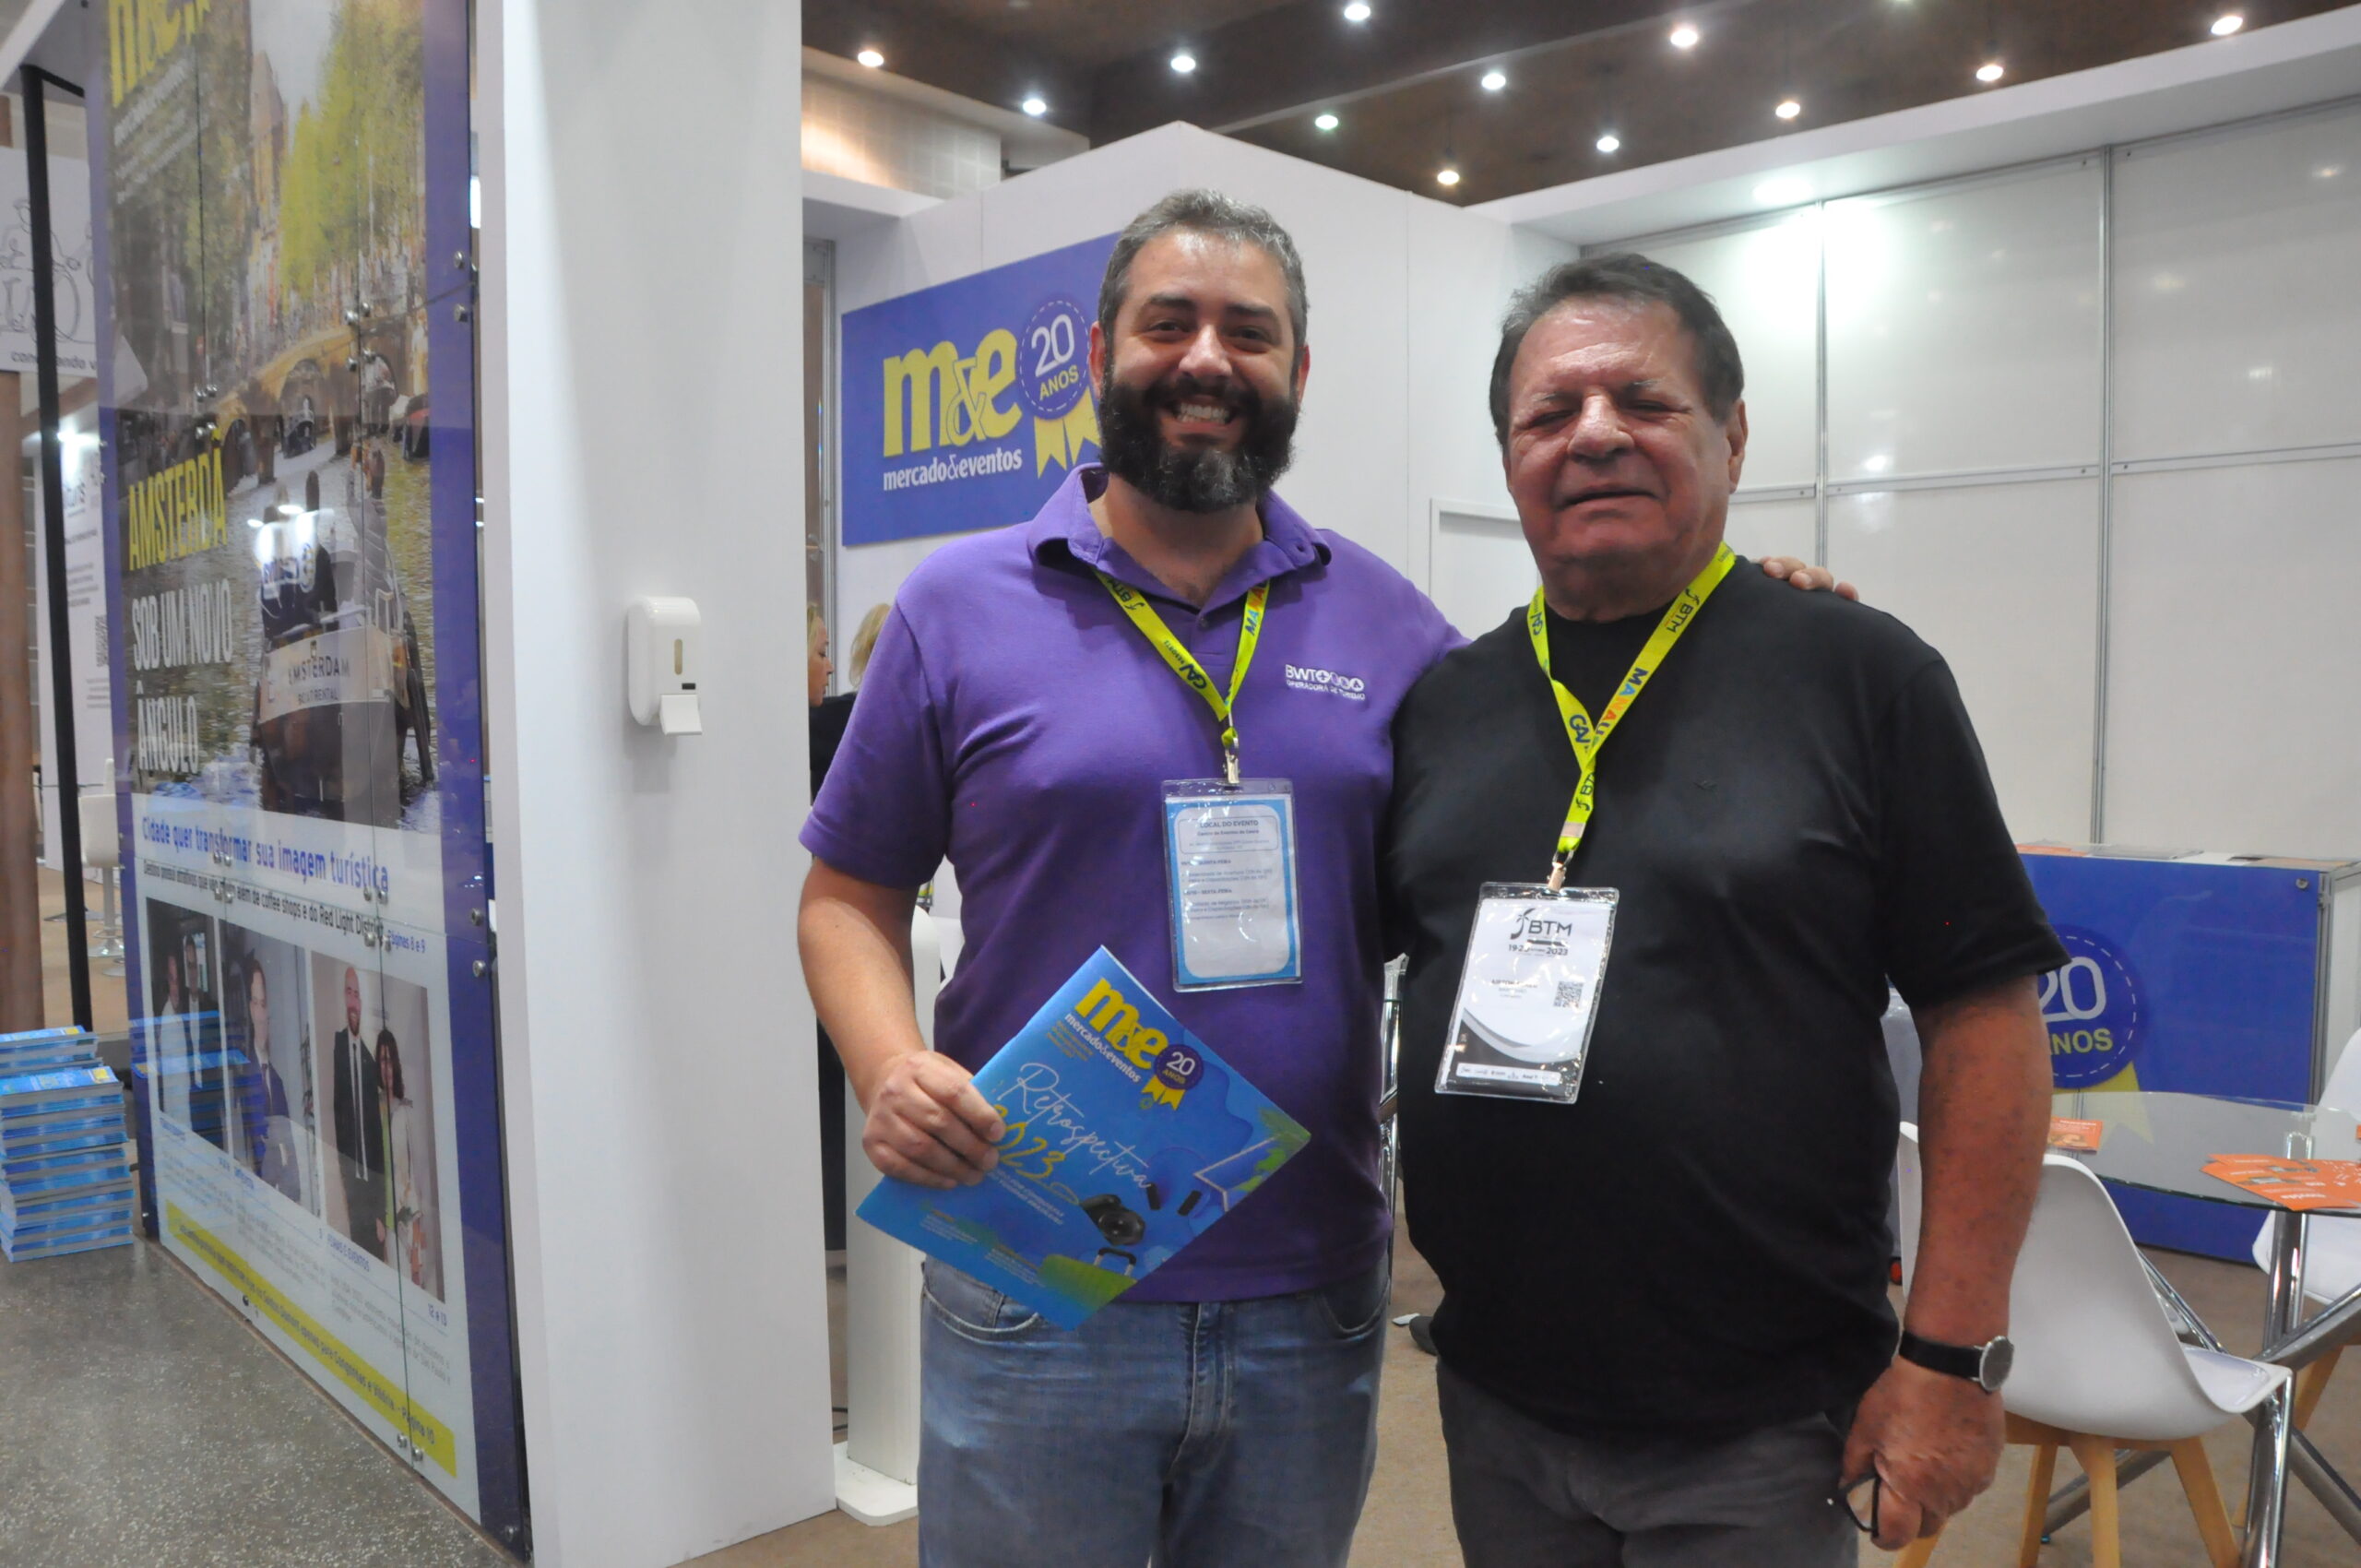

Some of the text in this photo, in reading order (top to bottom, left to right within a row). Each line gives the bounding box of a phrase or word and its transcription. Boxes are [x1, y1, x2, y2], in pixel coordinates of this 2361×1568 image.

[1030, 314, 1075, 378] 20
[883, 328, 1023, 457] m&e
[1038, 365, 1080, 401] ANOS
[883, 447, 1023, 491] mercado&eventos
[132, 595, 160, 671] SOB
[160, 588, 186, 668] UM
[188, 578, 232, 664] NOVO
[1667, 602, 1694, 634] BTM
[1286, 679, 1329, 693] OPERADORA
[136, 680, 199, 774] ÂNGULO
[1579, 772, 1596, 797] BT
[1199, 818, 1259, 828] LOCAL DO EVENTO
[142, 816, 389, 892] Cidade quer transformar sua imagem turística
[282, 896, 302, 921] shops
[309, 899, 318, 923] do
[319, 906, 335, 928] Red
[336, 909, 354, 936] Light
[1528, 920, 1572, 937] BTM
[1546, 947, 1569, 956] 2023
[2038, 956, 2107, 1023] 20
[1074, 978, 1169, 1070] m&e
[2051, 1028, 2113, 1055] NOS
[1064, 1013, 1142, 1084] mercado&eventos
[1167, 1051, 1196, 1076] 20
[1162, 1069, 1186, 1085] ANOS
[997, 1062, 1152, 1189] Retrospectiva
